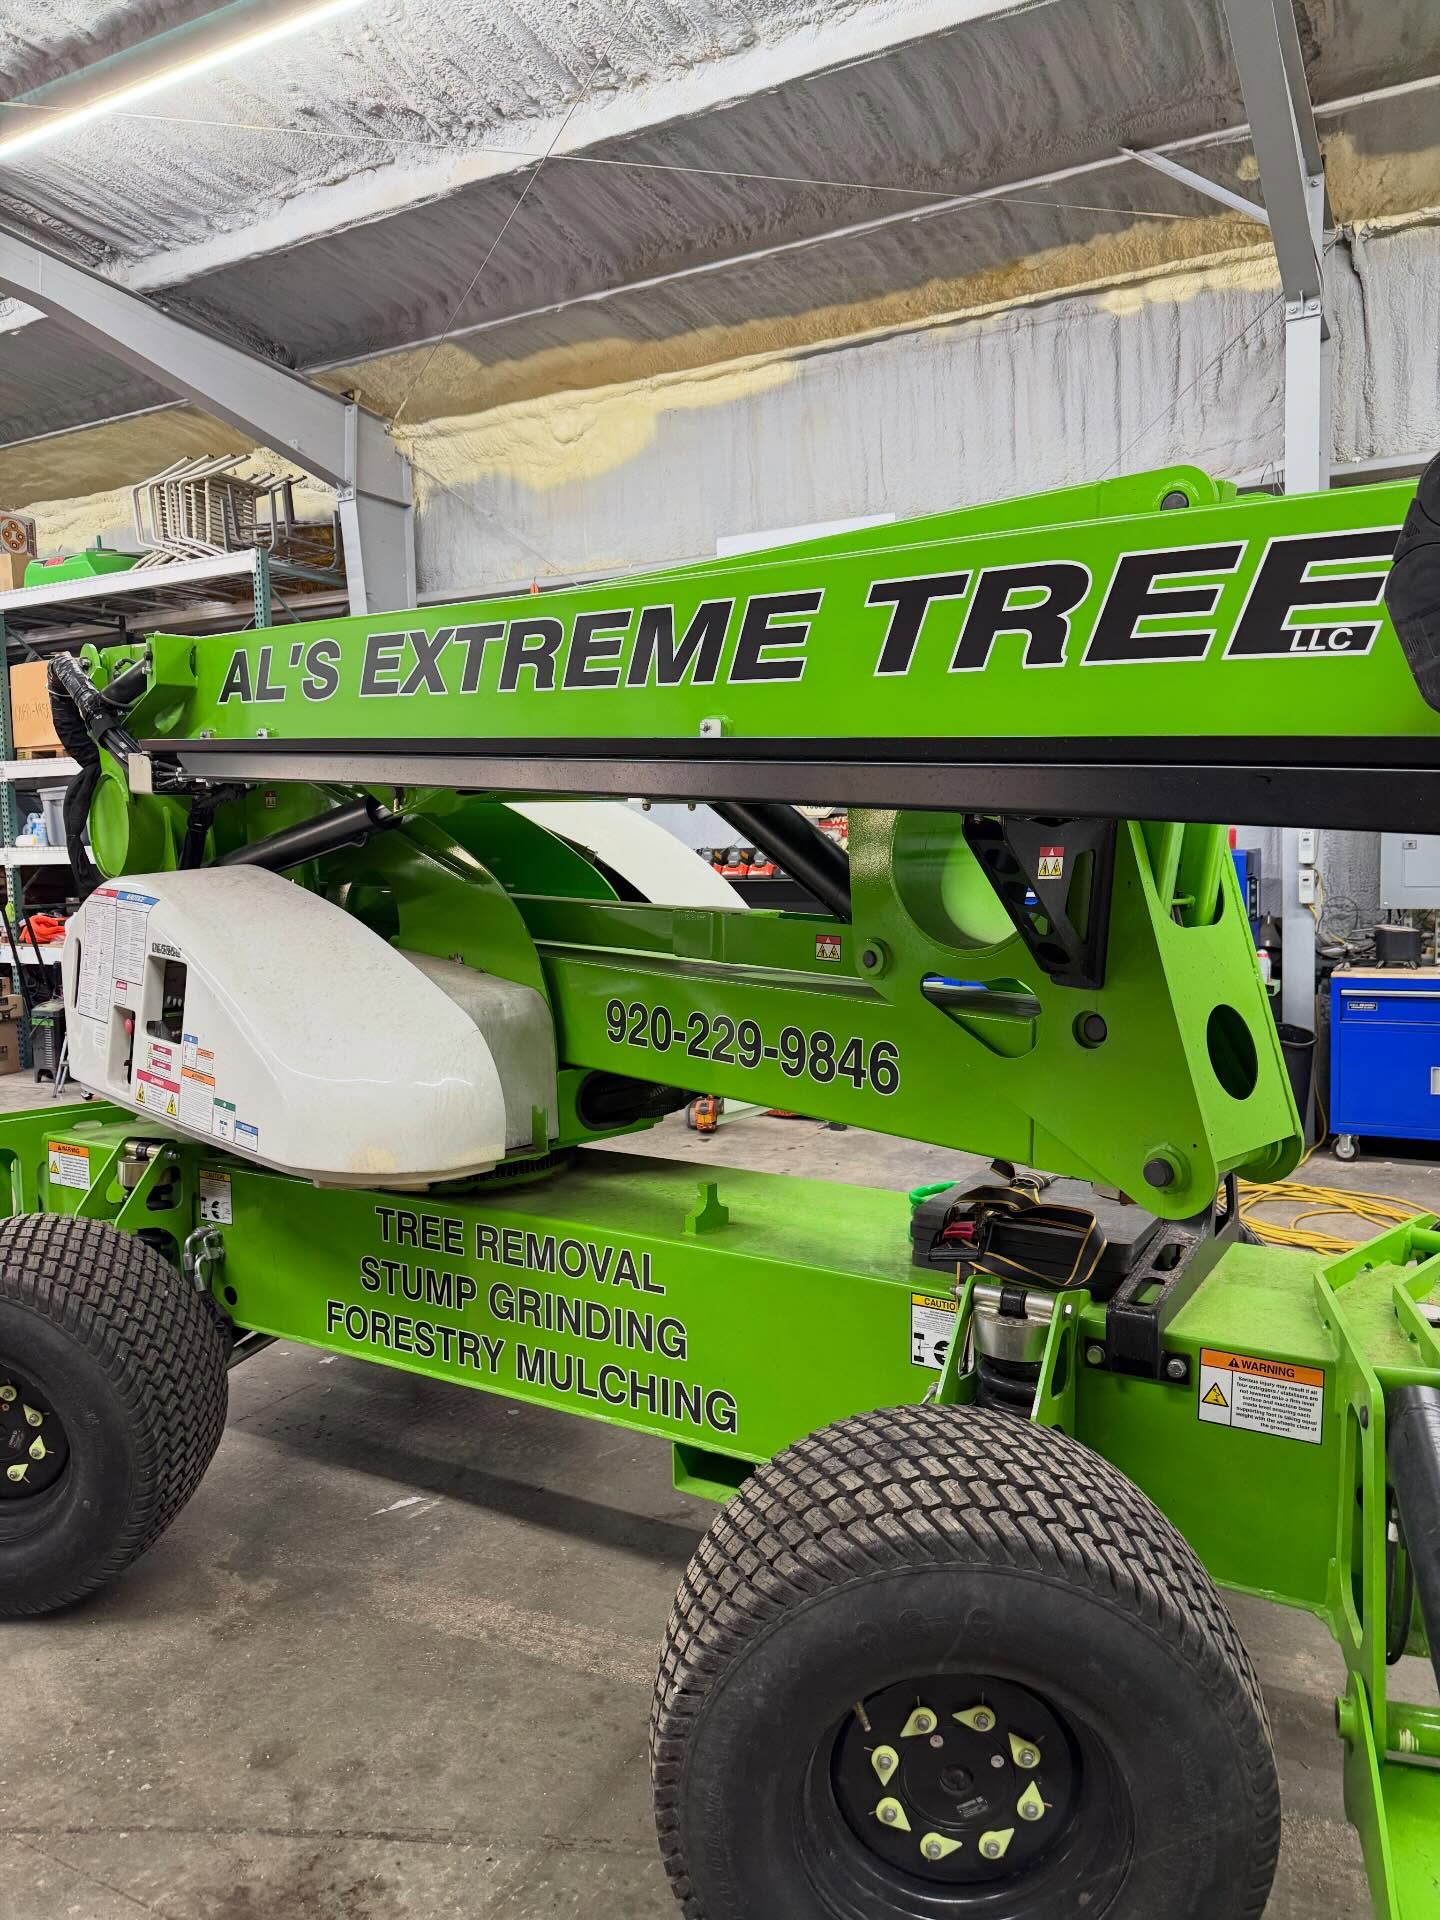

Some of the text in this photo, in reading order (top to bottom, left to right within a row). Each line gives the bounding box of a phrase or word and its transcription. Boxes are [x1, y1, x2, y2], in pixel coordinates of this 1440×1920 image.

[217, 525, 1402, 706] AL'S EXTREME TREE
[1290, 627, 1354, 652] LLC
[606, 998, 902, 1096] 920-229-9846
[375, 1205, 666, 1296] TREE REMOVAL
[359, 1255, 689, 1362] STUMP GRINDING
[924, 1297, 956, 1311] CAUTIO
[325, 1299, 739, 1435] FORESTRY MULCHING
[1241, 1359, 1295, 1378] WARNING
